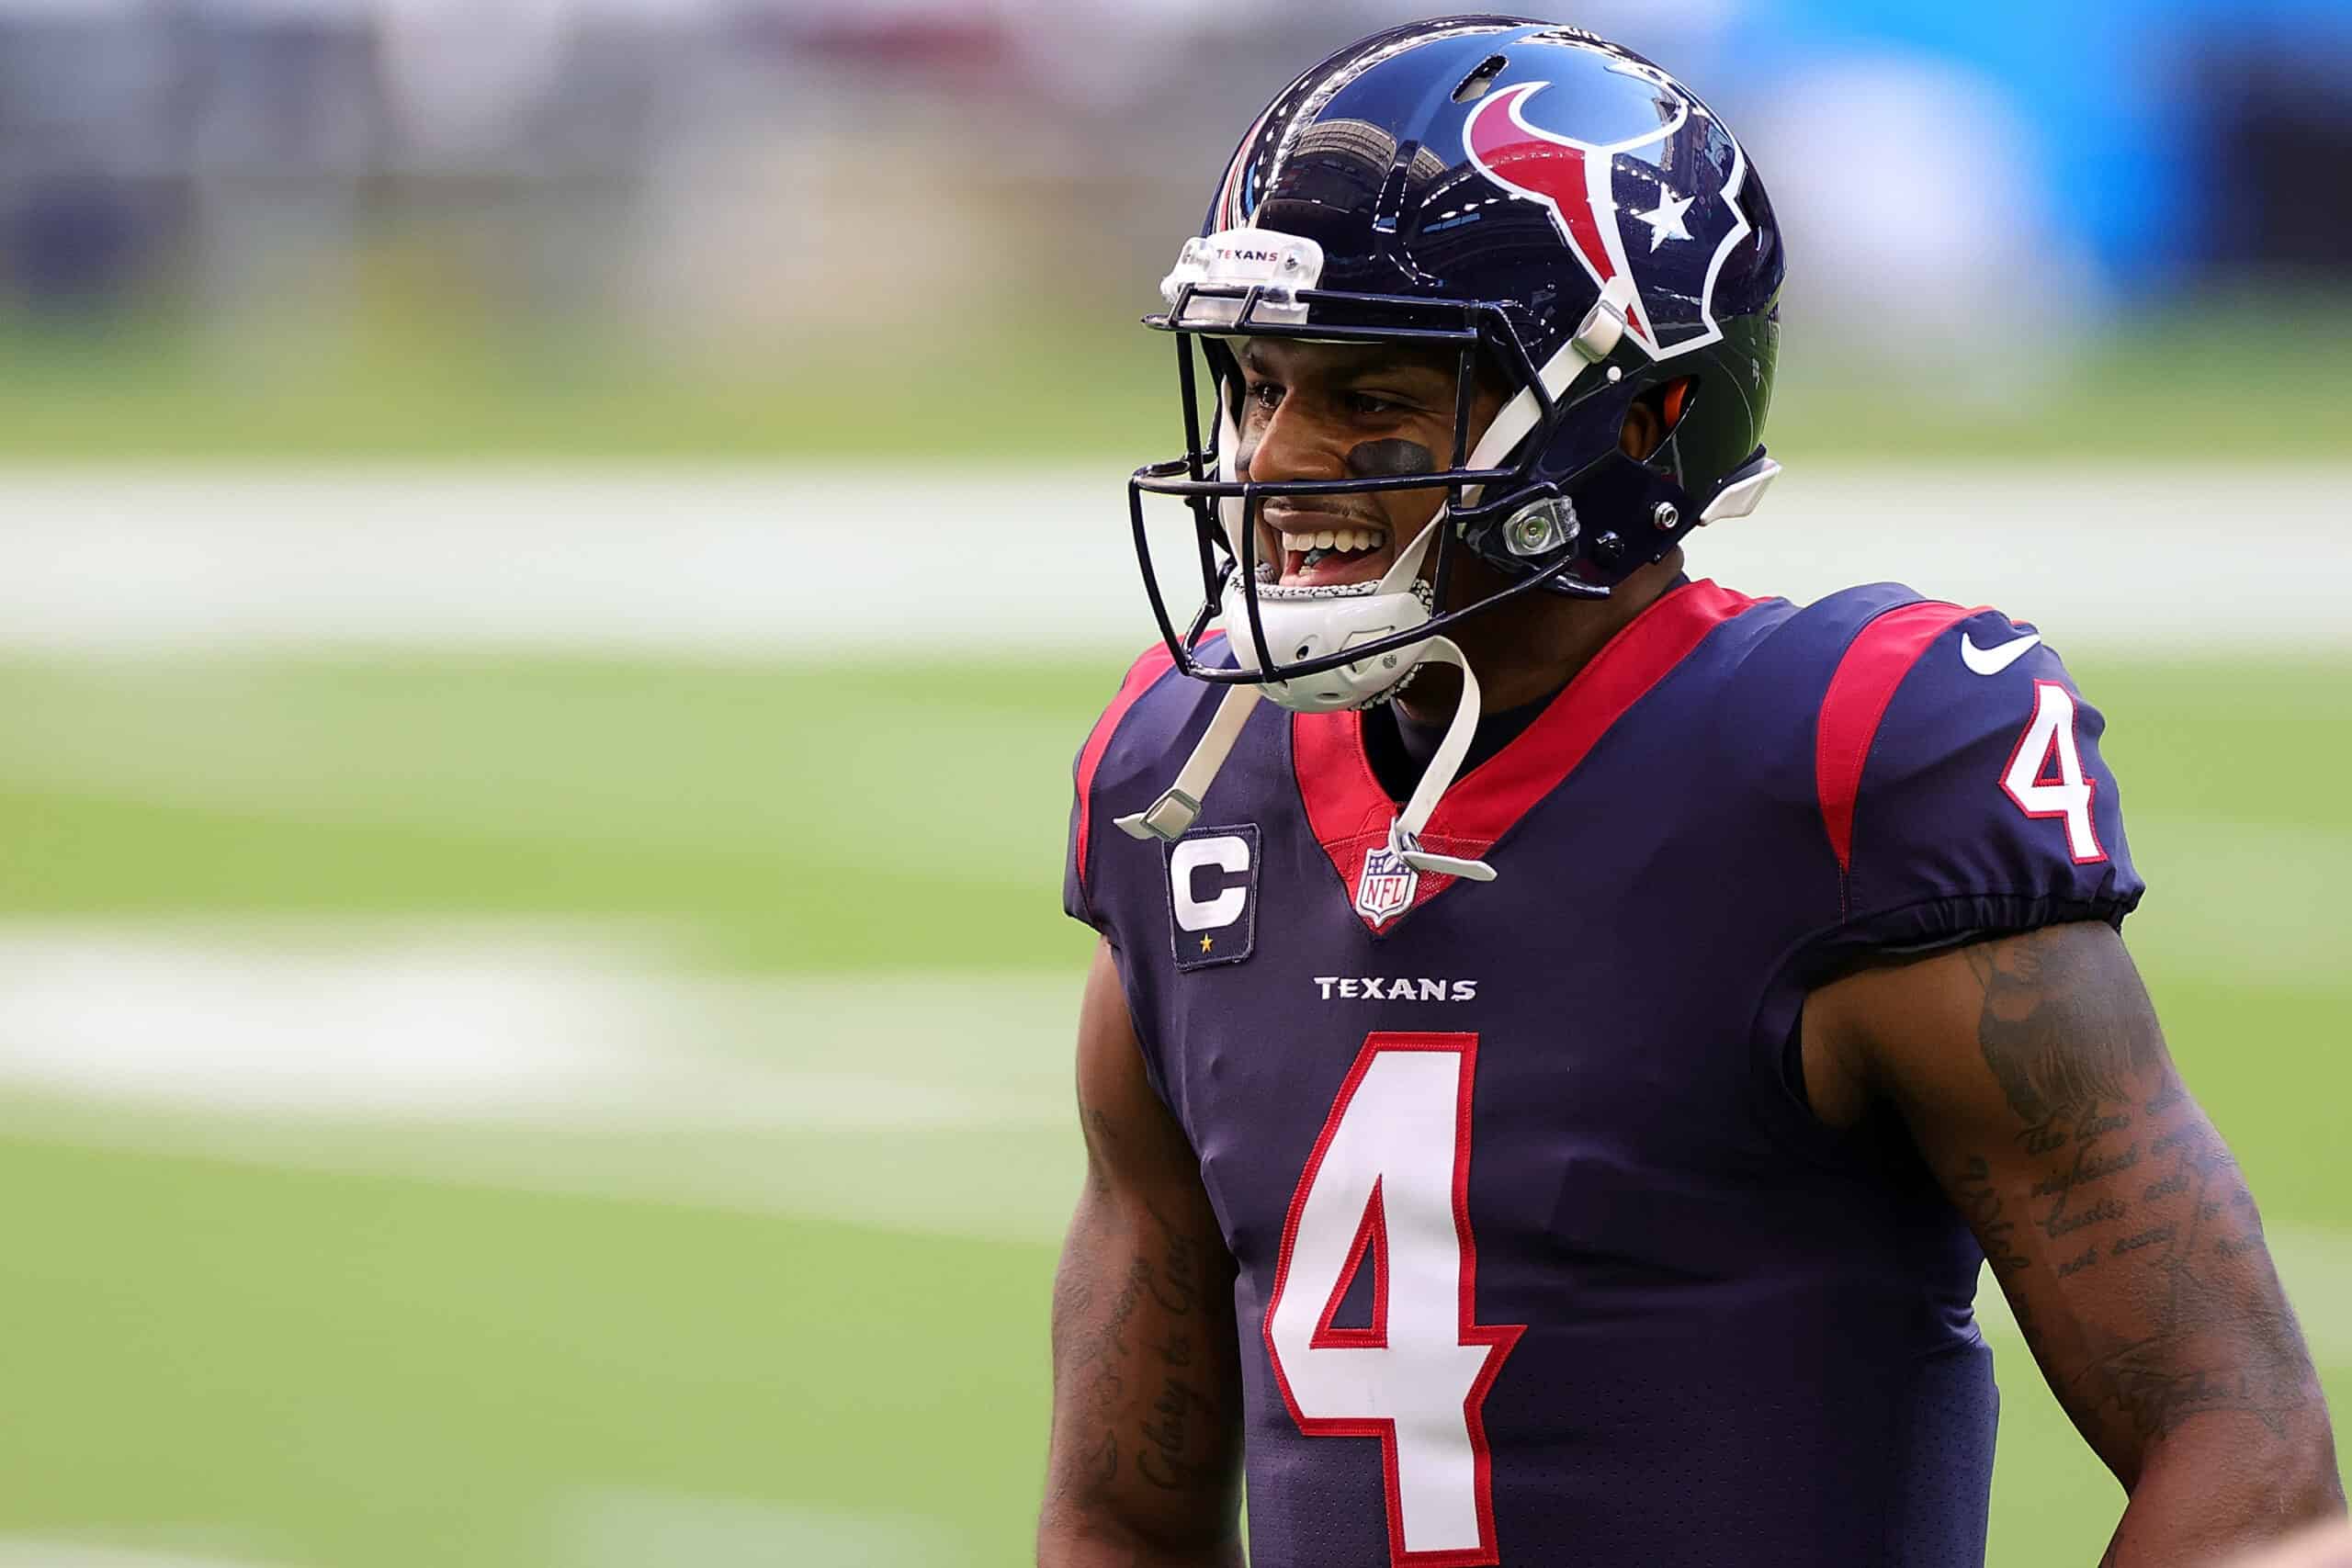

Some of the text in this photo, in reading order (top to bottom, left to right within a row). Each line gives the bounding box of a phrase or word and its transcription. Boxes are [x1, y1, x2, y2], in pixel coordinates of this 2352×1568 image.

[1216, 249, 1278, 262] TEXANS
[1997, 678, 2109, 865] 4
[1170, 836, 1250, 932] C
[1363, 877, 1403, 908] NFL
[1313, 976, 1478, 1001] TEXANS
[1262, 1031, 1528, 1567] 4
